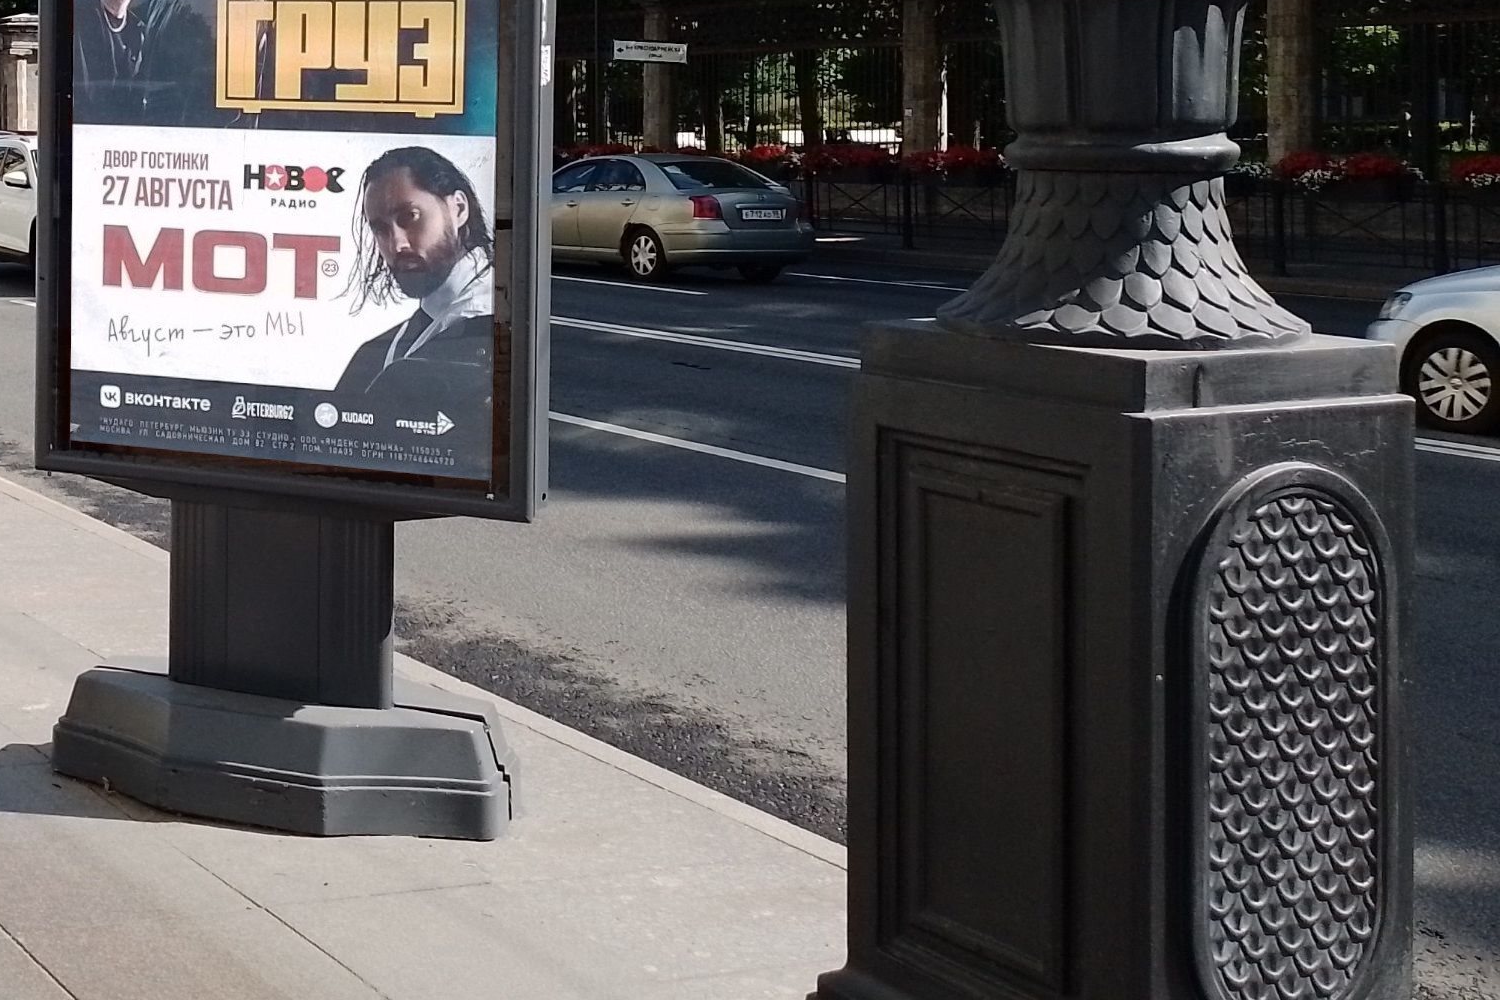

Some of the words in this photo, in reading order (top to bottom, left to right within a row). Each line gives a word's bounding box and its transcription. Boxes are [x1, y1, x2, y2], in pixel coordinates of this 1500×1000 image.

[226, 0, 456, 103] ГРУЗ
[102, 150, 138, 170] ДВОР
[141, 151, 209, 172] ГОСТИНКИ
[102, 175, 130, 206] 27
[134, 176, 234, 211] АВГУСТА
[270, 197, 318, 209] РАДИО
[102, 224, 341, 300] МОТ
[323, 262, 337, 274] 23
[108, 315, 185, 357] Август
[219, 324, 256, 340] это
[265, 311, 304, 336] МЫ
[246, 402, 295, 420] PETERBURG2
[341, 412, 374, 425] KUDAGO
